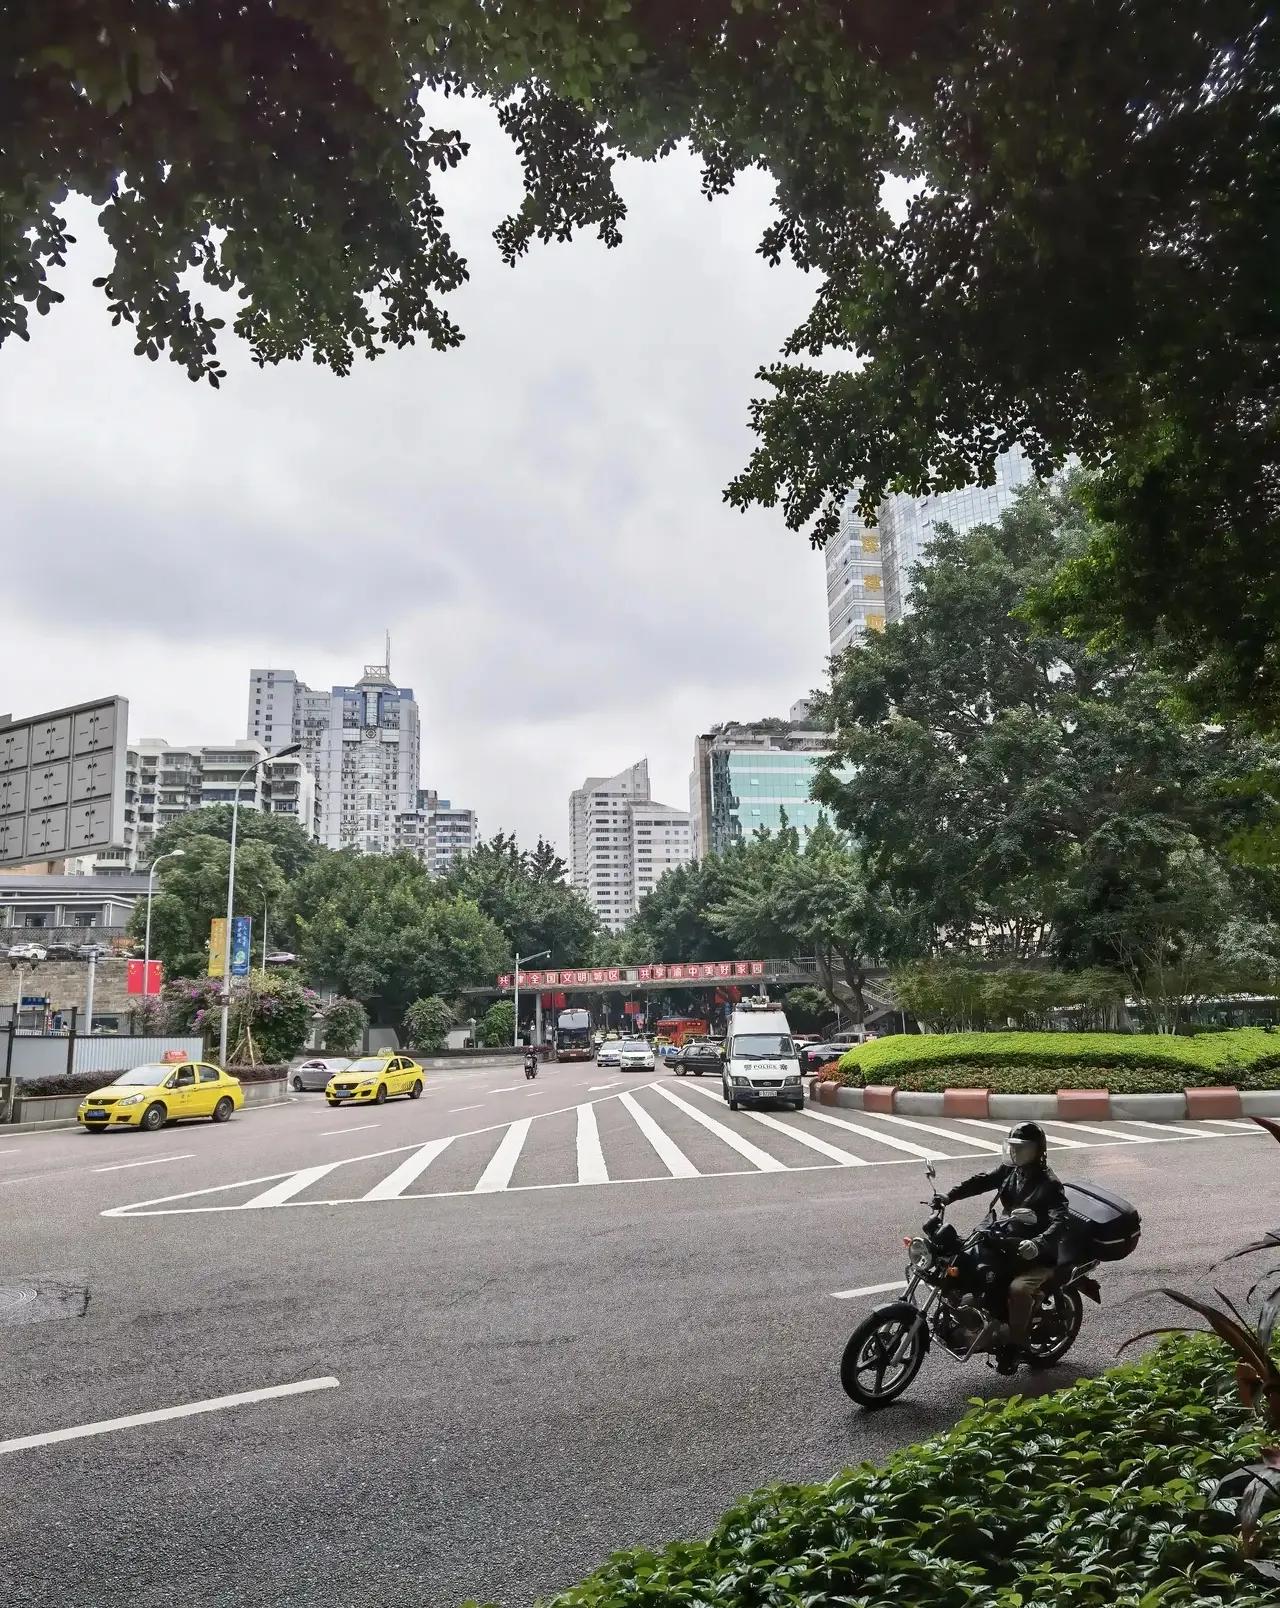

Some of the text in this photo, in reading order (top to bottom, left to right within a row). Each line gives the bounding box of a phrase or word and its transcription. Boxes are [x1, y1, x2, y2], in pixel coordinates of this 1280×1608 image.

[640, 962, 762, 979] 共享渝中美好家园
